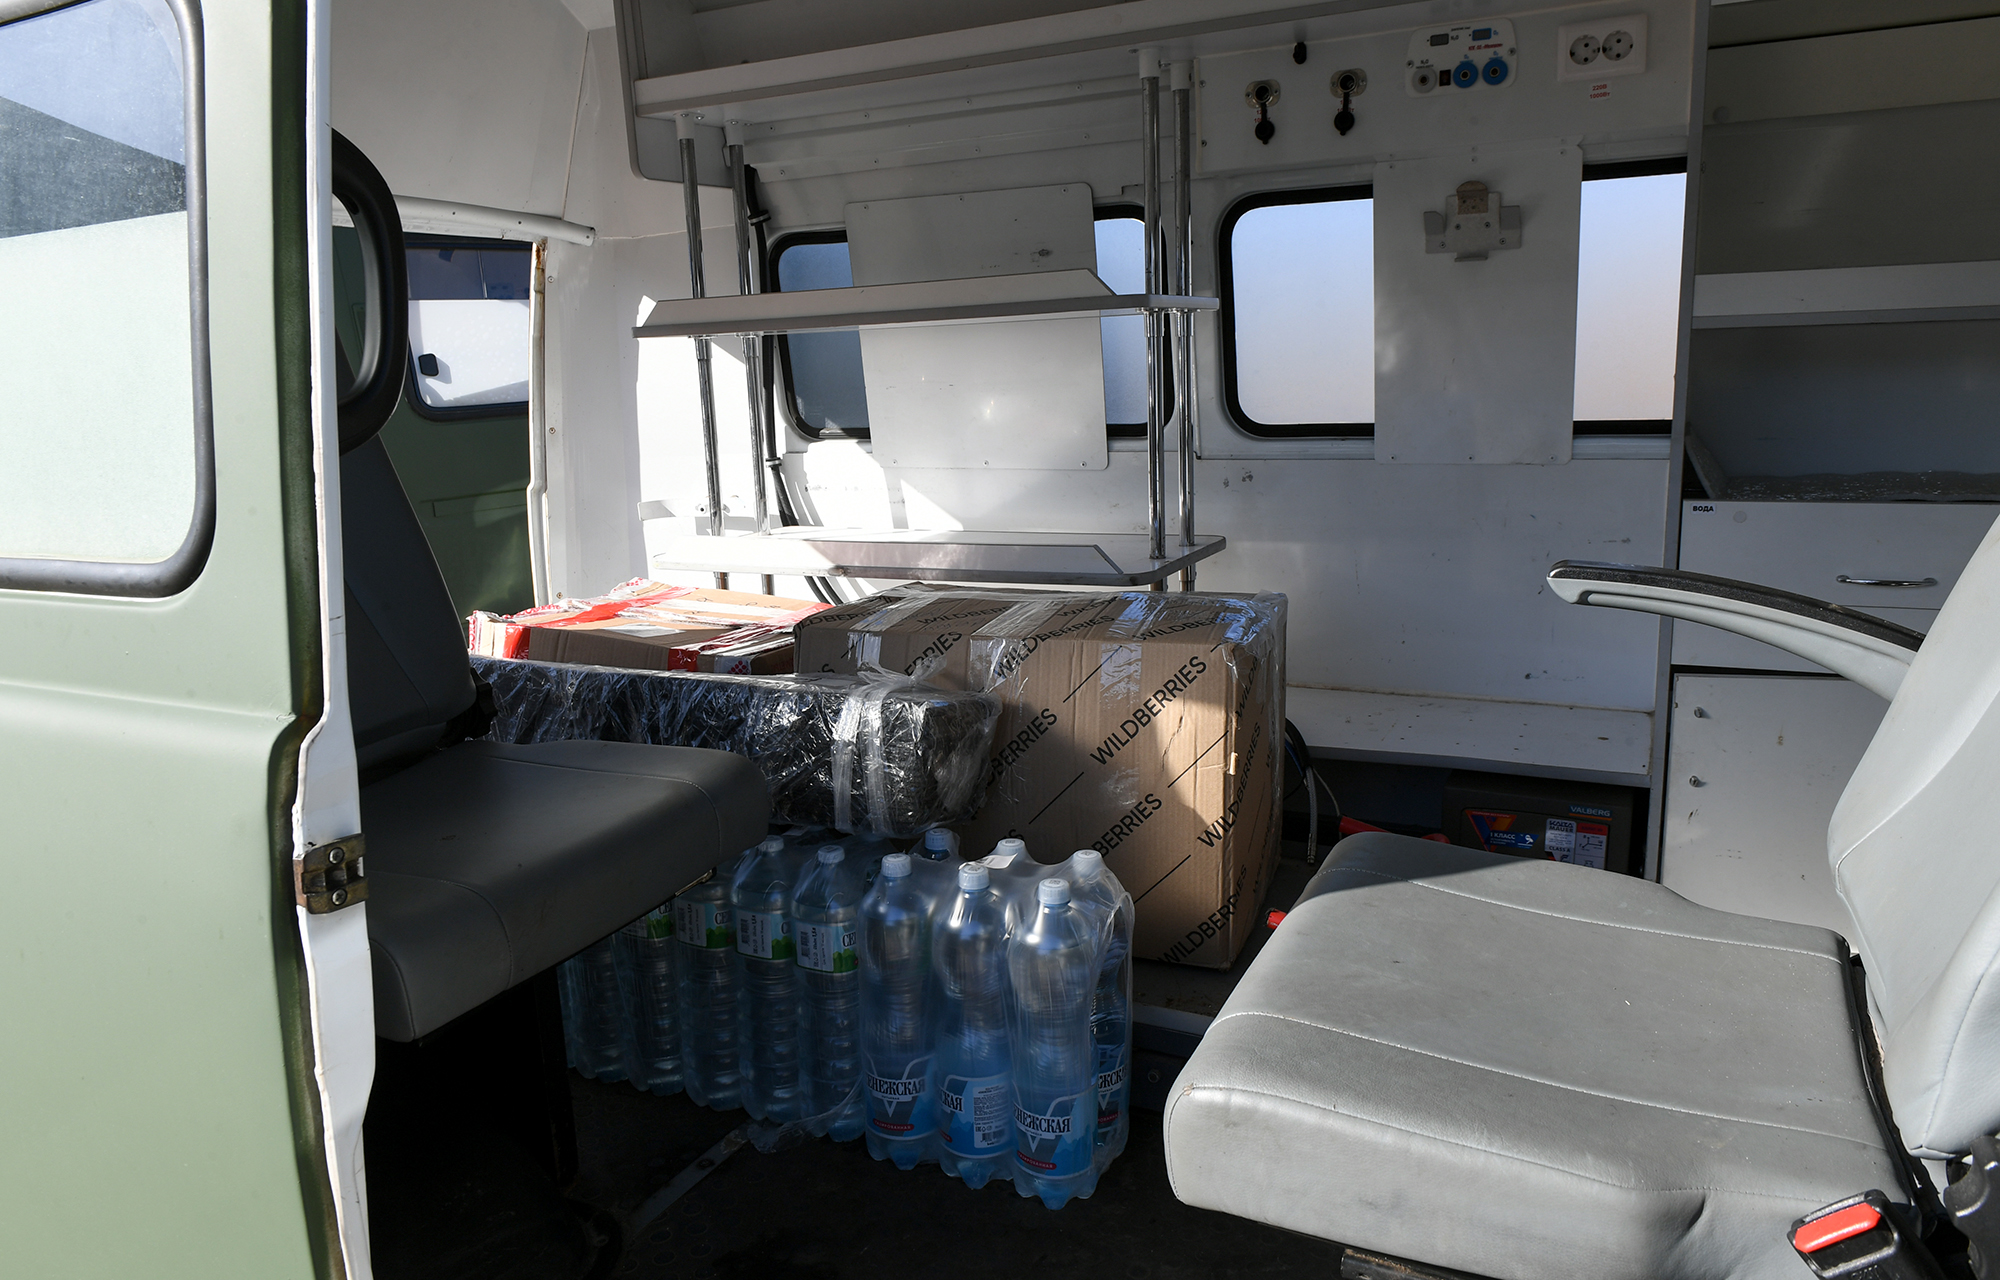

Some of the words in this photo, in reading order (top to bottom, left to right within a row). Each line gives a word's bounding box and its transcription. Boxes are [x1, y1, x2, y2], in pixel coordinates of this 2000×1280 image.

[1692, 505, 1714, 513] ВОДА
[1089, 656, 1208, 766] WILDBERRIES
[1197, 722, 1261, 849] WILDBERRIES
[1570, 805, 1611, 817] VALBERG
[1548, 826, 1574, 834] MAUER
[1493, 832, 1516, 840] КЛАСС
[1548, 845, 1566, 853] CLASS
